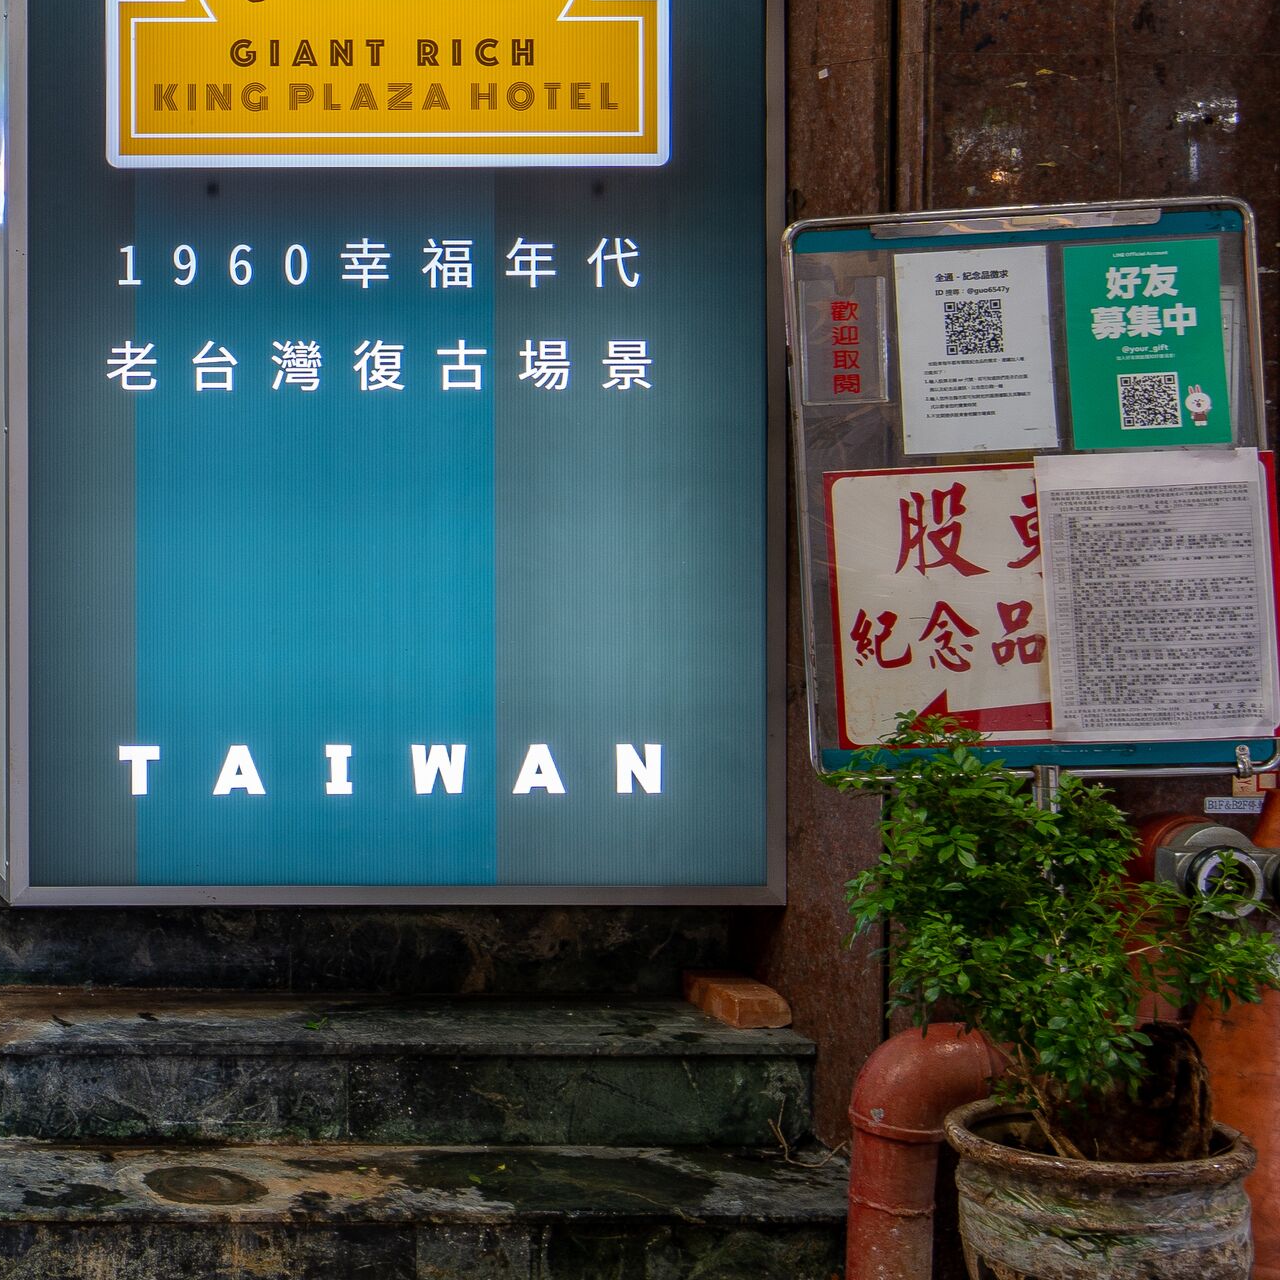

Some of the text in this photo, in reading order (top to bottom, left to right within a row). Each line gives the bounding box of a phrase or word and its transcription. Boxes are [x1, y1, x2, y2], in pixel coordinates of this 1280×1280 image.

[229, 38, 536, 68] GIANT RICH
[153, 81, 619, 112] KING PLAZA HOTEL
[117, 237, 641, 289] 1960幸福年代
[1105, 264, 1179, 300] 好友
[1090, 302, 1198, 341] 募集中
[105, 339, 653, 392] 老台灣復古場景
[830, 300, 862, 395] 歡迎取閱
[1121, 344, 1169, 355] @your_gift
[848, 599, 1047, 673] 紀念品
[118, 743, 663, 796] TAIWAN
